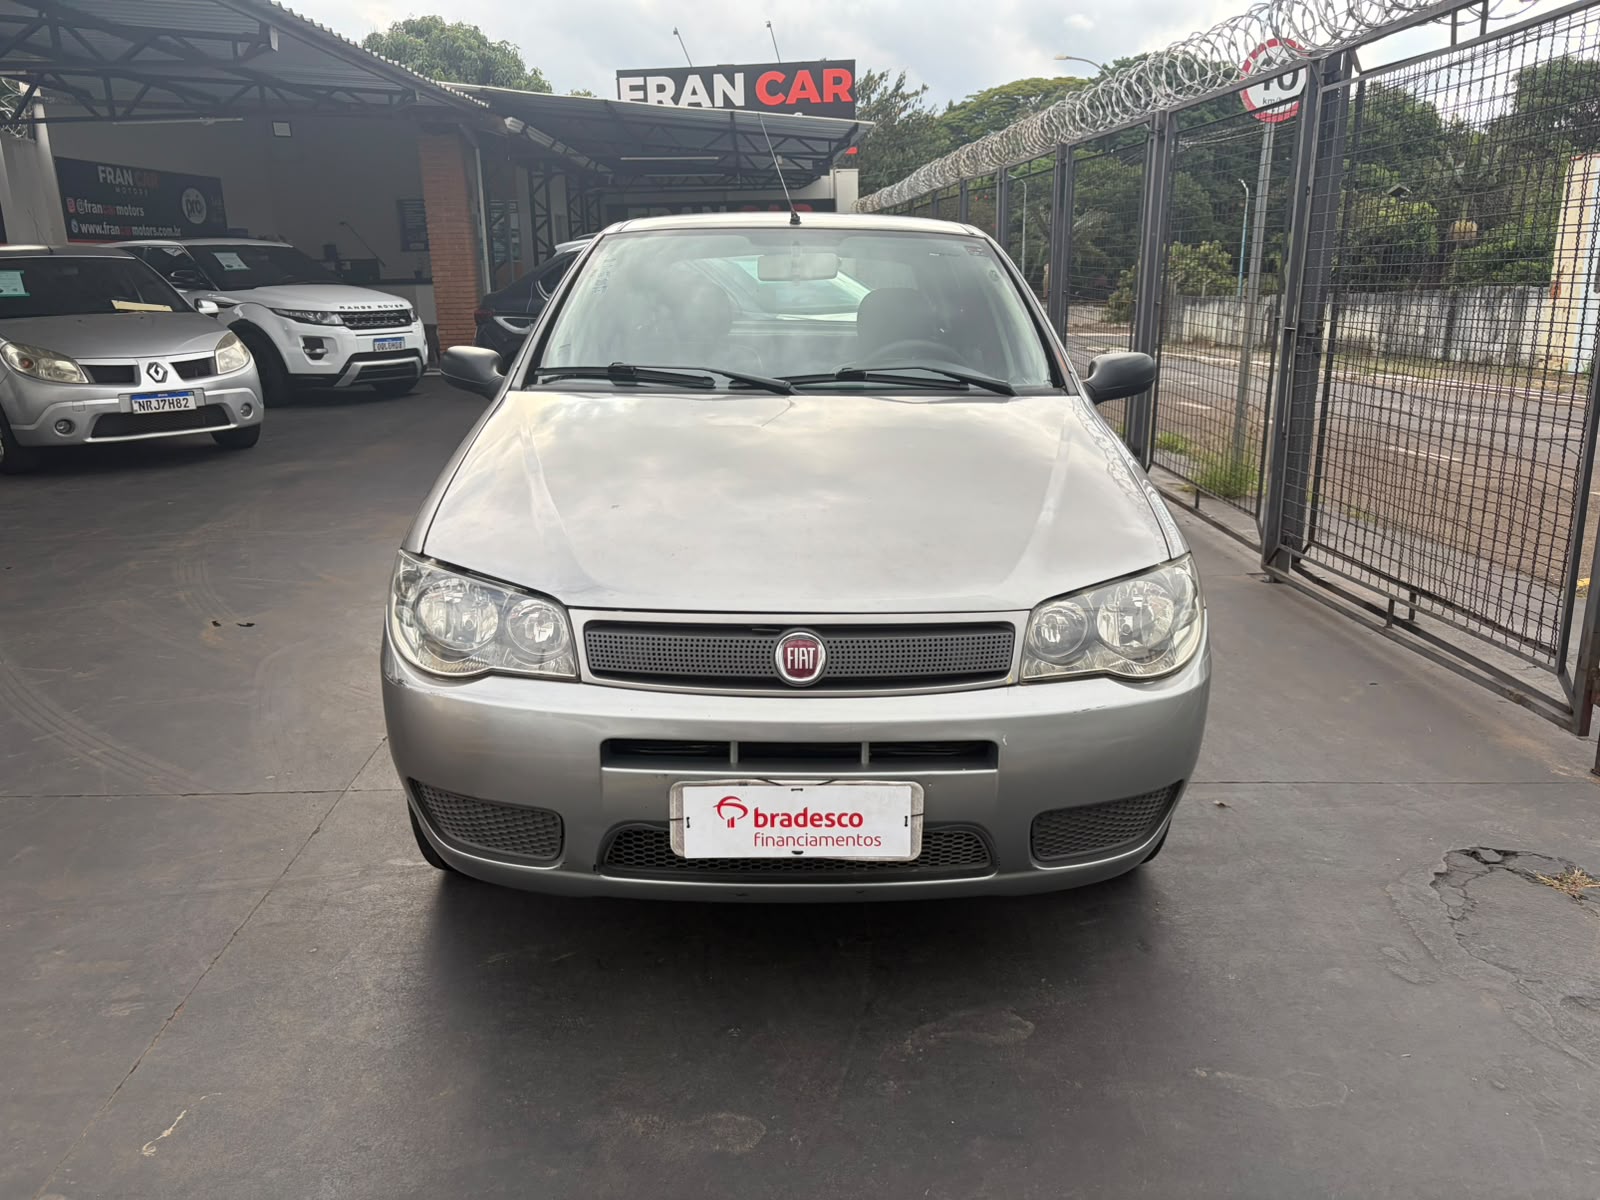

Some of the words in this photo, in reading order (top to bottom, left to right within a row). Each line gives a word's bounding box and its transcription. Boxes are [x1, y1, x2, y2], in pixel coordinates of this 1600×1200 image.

[619, 72, 745, 107] FRAN
[755, 68, 853, 106] CAR
[97, 165, 134, 186] FRAN
[138, 398, 189, 411] NRJ7H82
[787, 647, 816, 669] FIAT
[753, 806, 864, 828] bradesco
[753, 832, 882, 847] financiamentos
